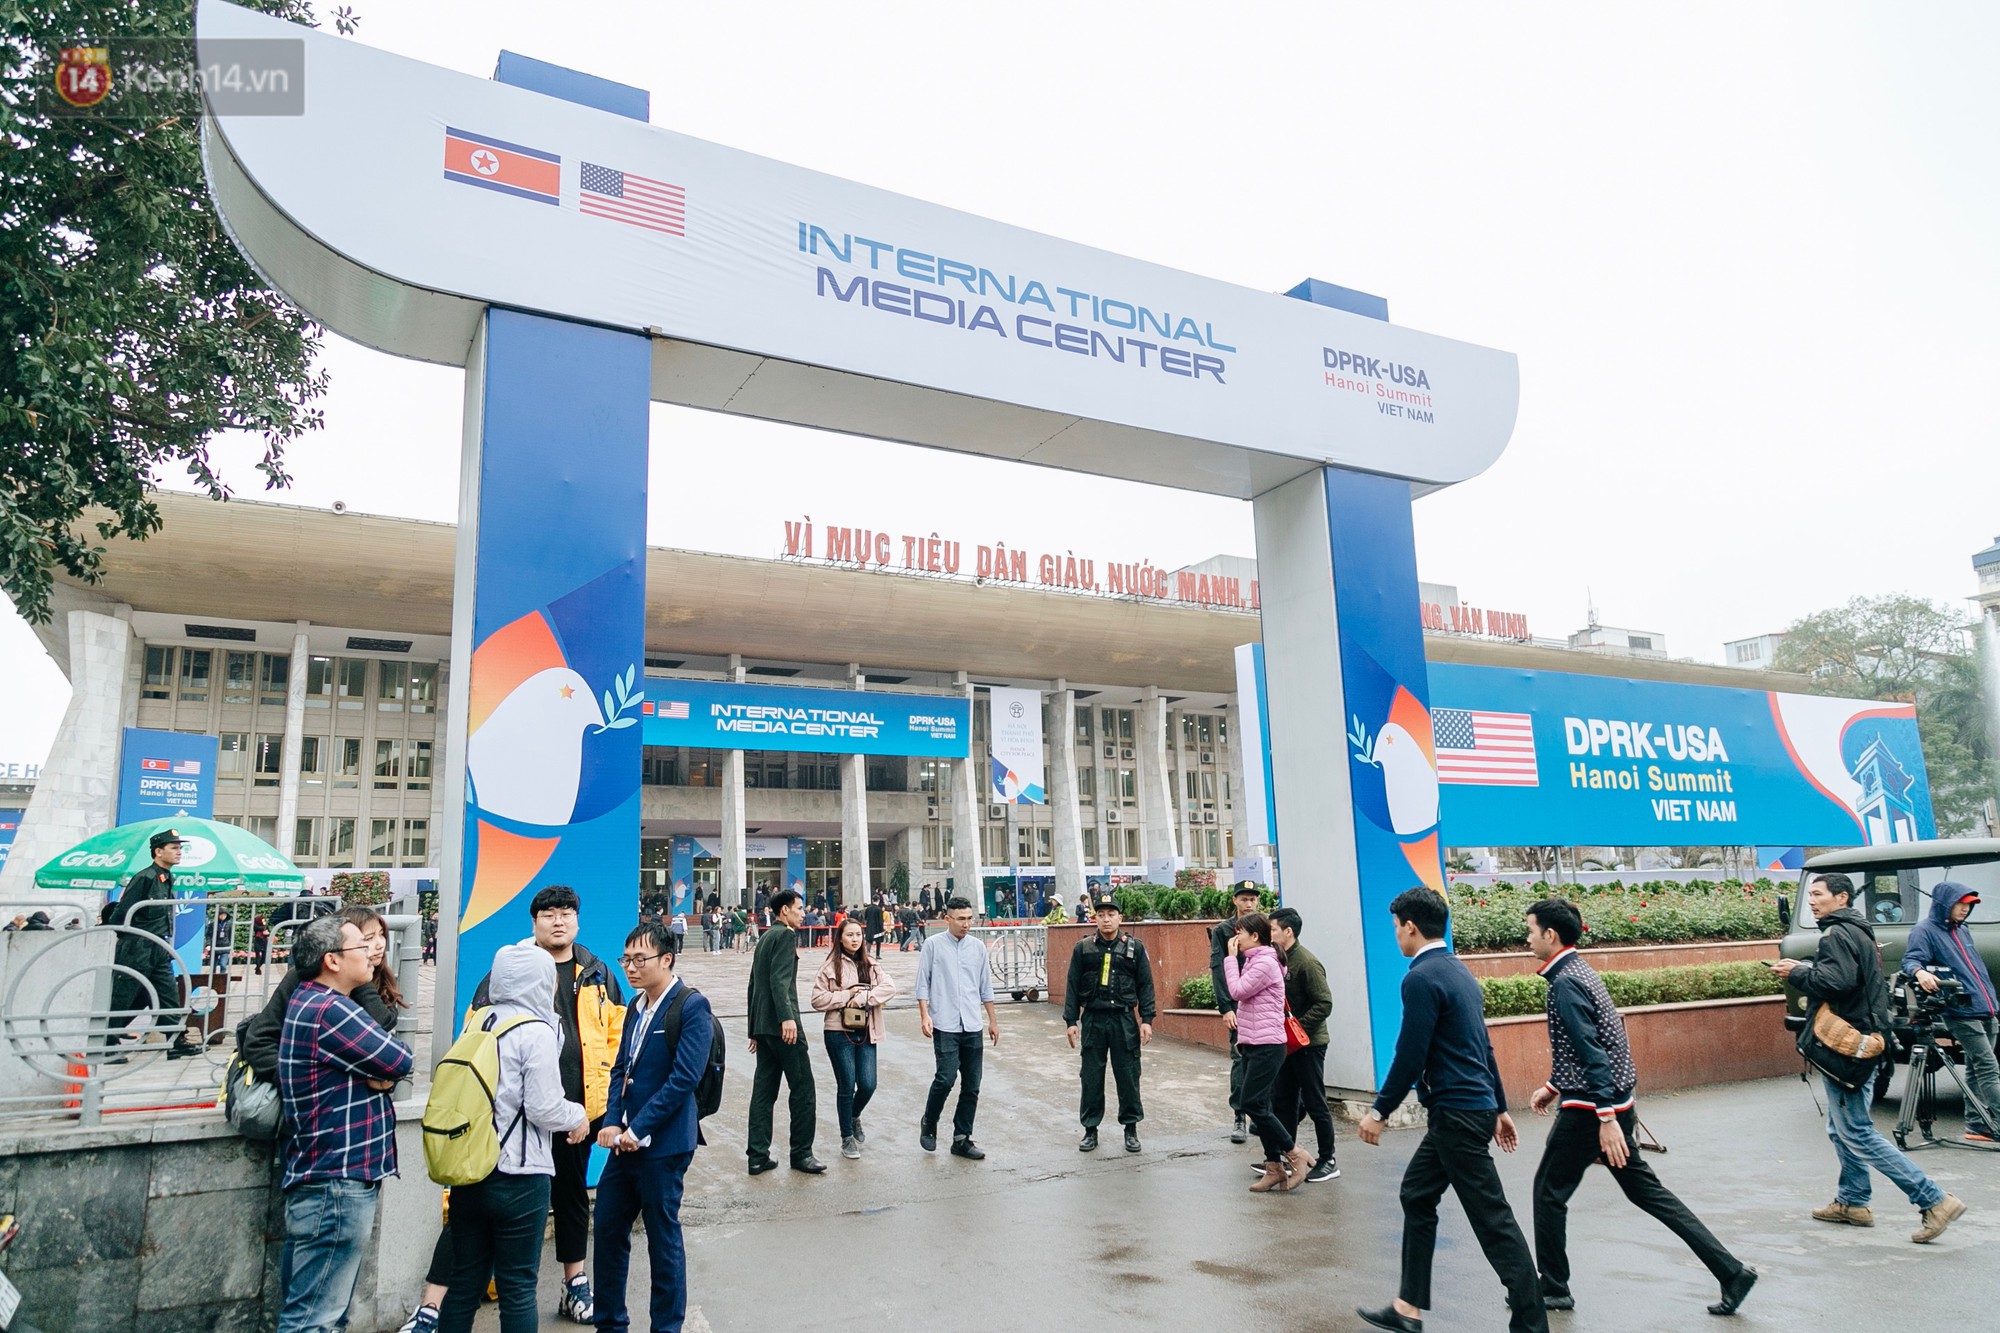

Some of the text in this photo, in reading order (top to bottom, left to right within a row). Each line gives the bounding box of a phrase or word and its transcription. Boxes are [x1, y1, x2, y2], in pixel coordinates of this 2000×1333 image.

[798, 222, 1237, 353] INTERNATIONAL
[816, 266, 1226, 384] MEDIA CENTER
[1323, 347, 1431, 390] DPRK-USA
[1325, 372, 1432, 407] Hanoi Summit
[1378, 401, 1434, 424] VIET NAM
[784, 515, 812, 557] VÌ
[826, 526, 891, 570] MỤC
[902, 532, 960, 574] TIÊU
[977, 541, 1026, 582] DÂN
[1108, 559, 1168, 599] NƯỚC
[1450, 601, 1483, 634] VĂN
[711, 704, 885, 725] INTERNATIONAL
[910, 715, 956, 726] DPRK-USA
[717, 719, 878, 738] MEDIA CENTER
[1564, 717, 1729, 762] DPRK-USA
[141, 779, 197, 792] DPRK-USA
[1569, 762, 1733, 793] Hanoi Summit
[140, 789, 164, 797] Hanoi
[1651, 799, 1737, 822] VIET NAM
[60, 850, 126, 867] Grab
[237, 853, 288, 869] Grab
